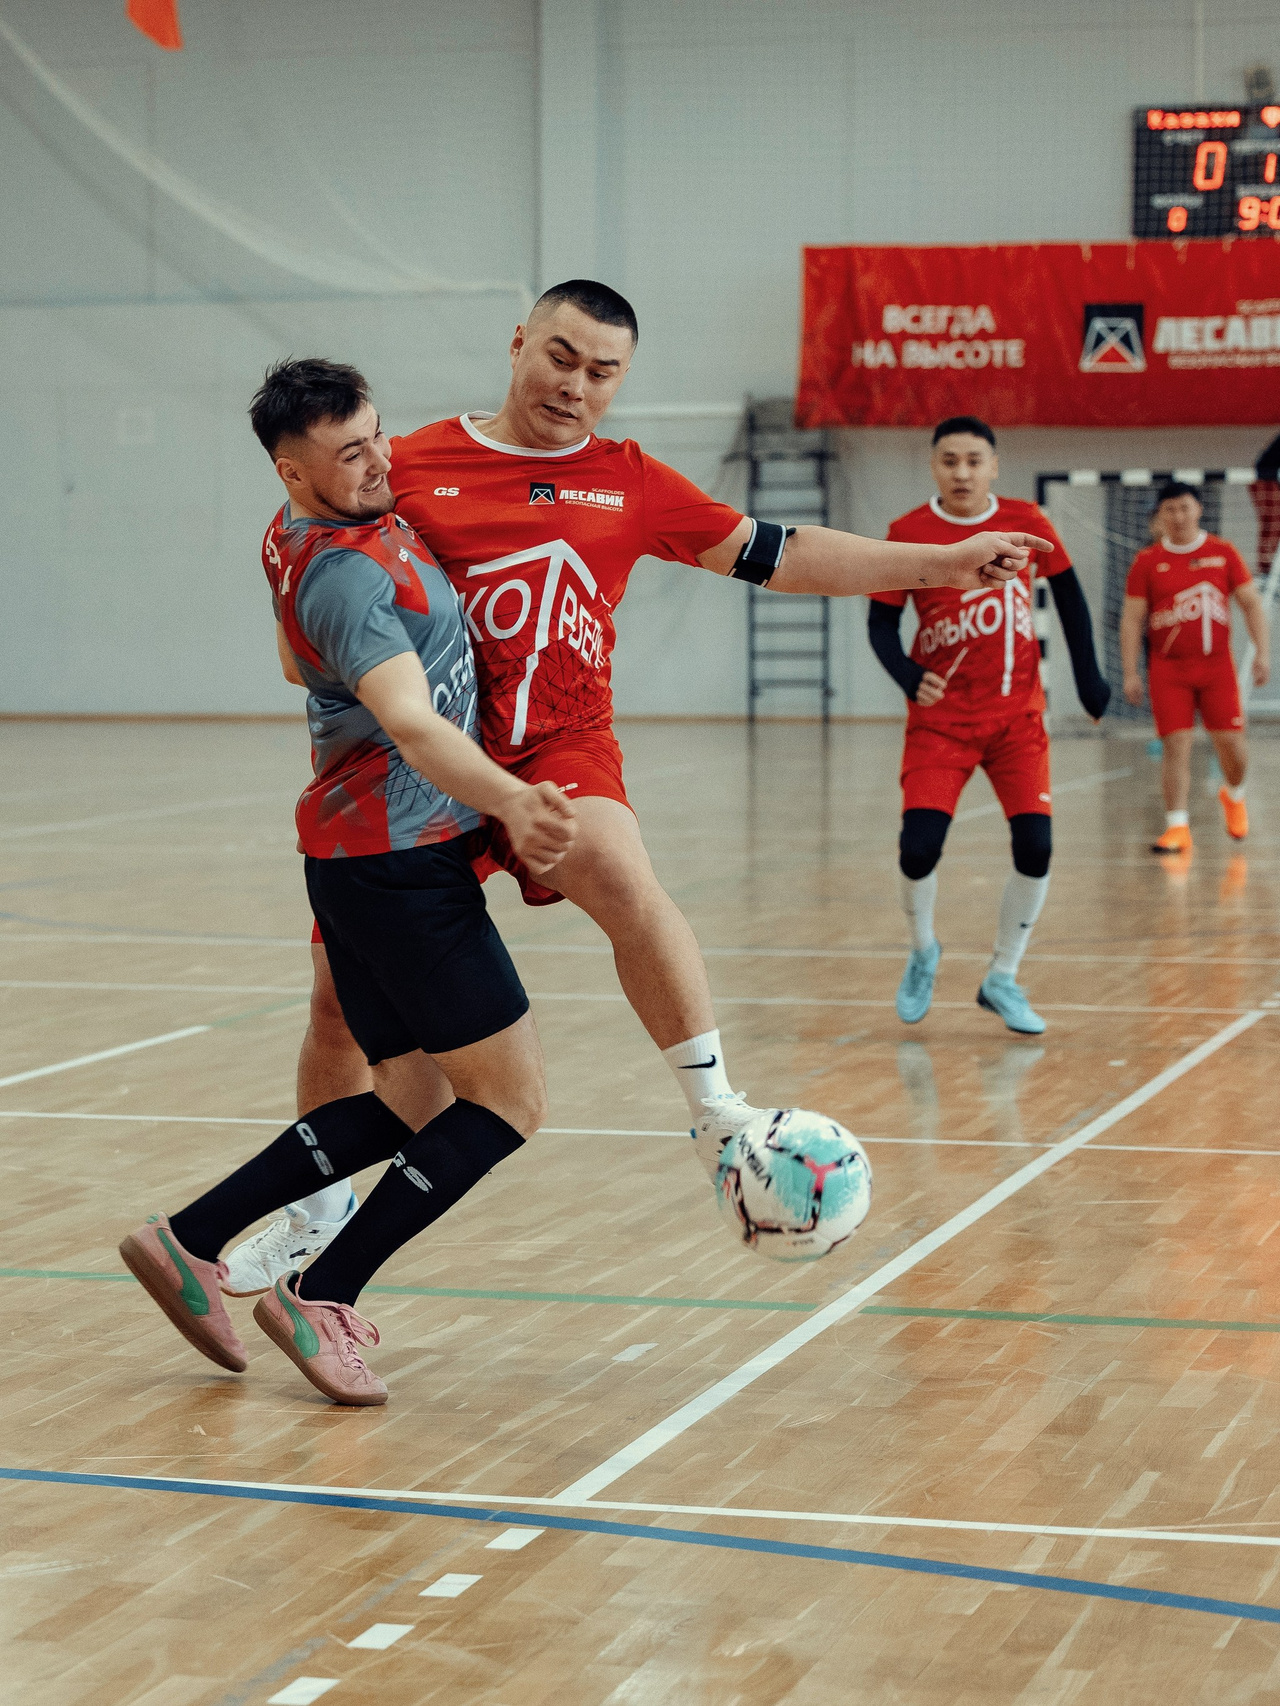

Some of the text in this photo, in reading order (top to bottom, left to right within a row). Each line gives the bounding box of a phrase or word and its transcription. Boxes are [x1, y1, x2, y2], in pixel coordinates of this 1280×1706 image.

[1192, 140, 1228, 191] 0
[882, 304, 997, 338] ВСЕГДА
[851, 338, 1026, 370] НА ВЫСОТЕ
[433, 486, 460, 498] GS
[559, 489, 624, 508] ЛЕСАВИК
[295, 1122, 334, 1176] GS
